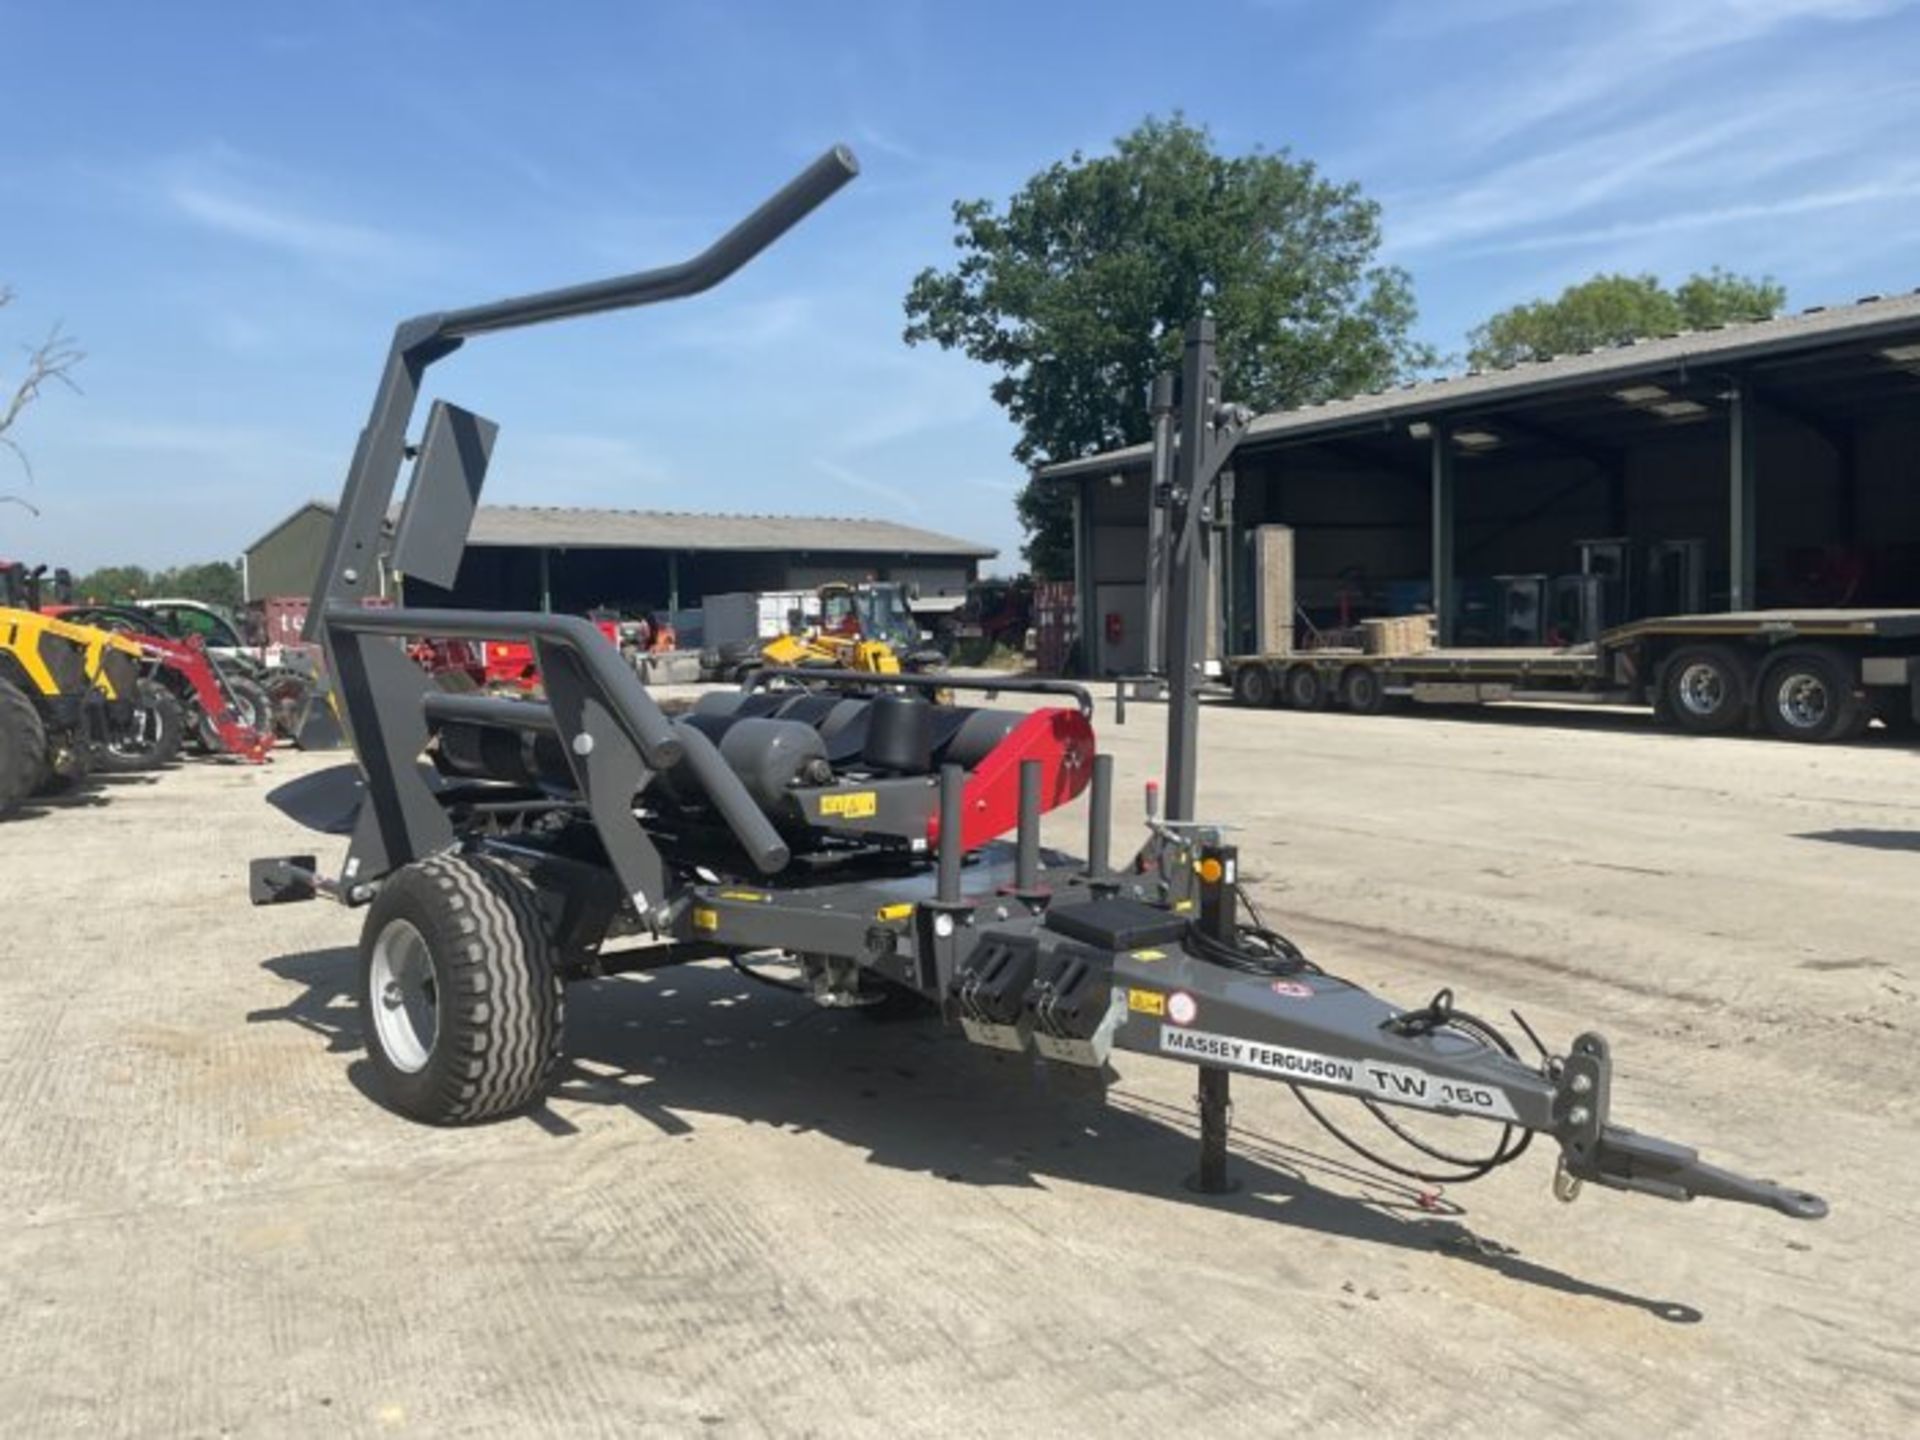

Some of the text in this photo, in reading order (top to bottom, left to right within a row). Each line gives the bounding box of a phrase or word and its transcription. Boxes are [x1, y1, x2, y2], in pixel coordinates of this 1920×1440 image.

[1167, 1032, 1243, 1059] MASSEY
[1250, 1047, 1353, 1081] FERGUSON
[1368, 1069, 1426, 1097] TW
